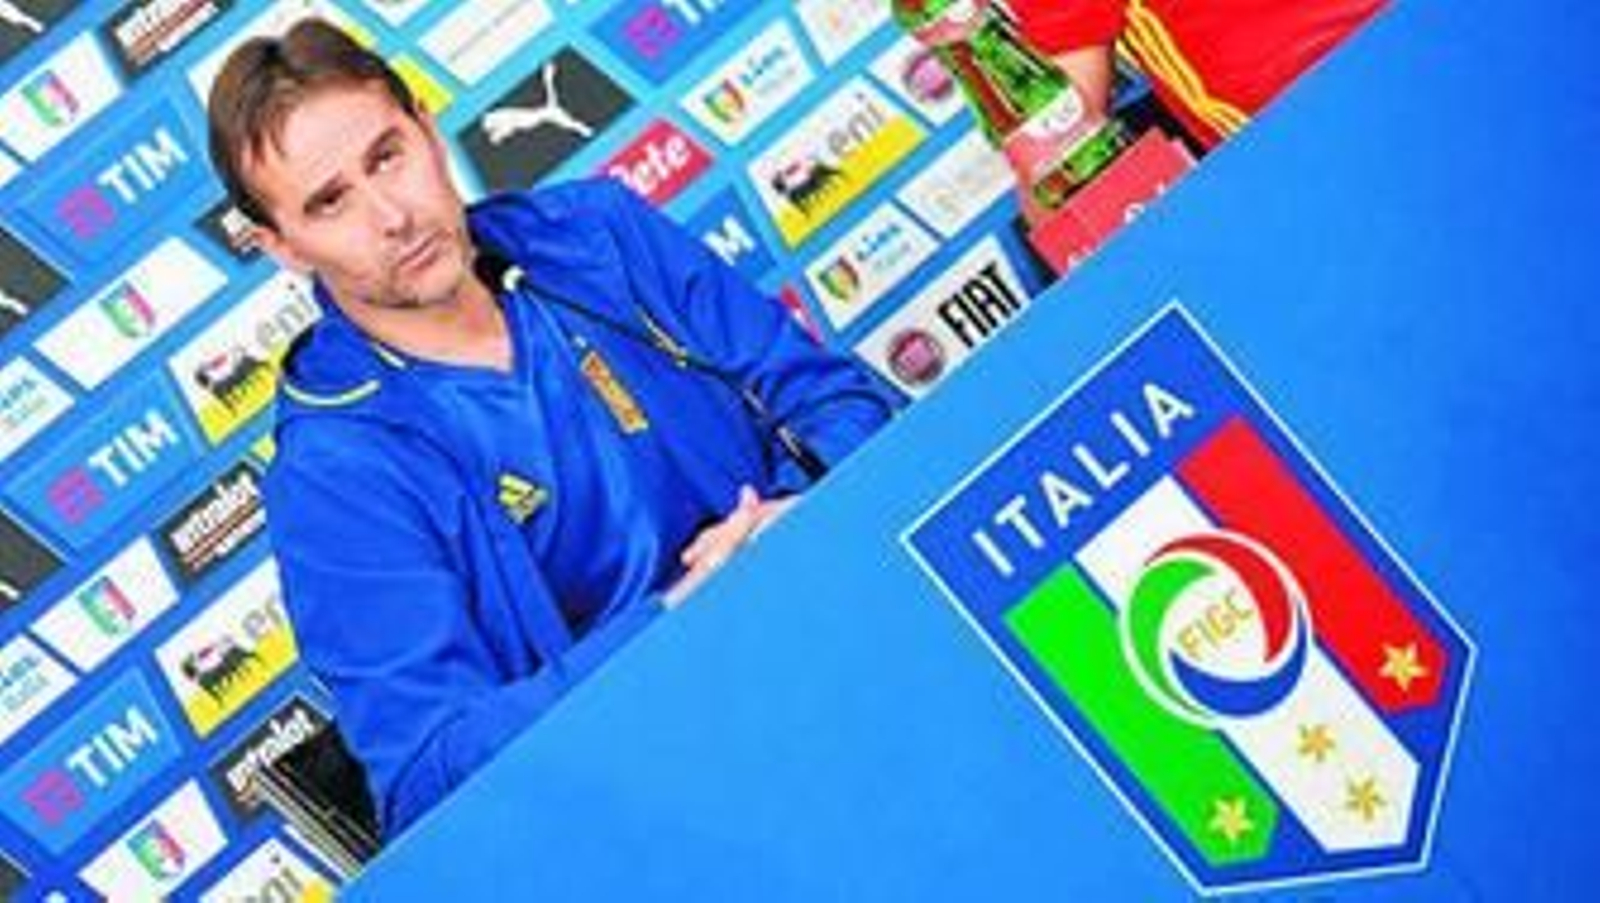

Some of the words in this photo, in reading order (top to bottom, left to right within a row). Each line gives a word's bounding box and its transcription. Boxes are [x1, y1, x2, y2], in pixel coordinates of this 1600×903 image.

[827, 91, 885, 156] eni
[98, 126, 190, 204] TIM
[938, 261, 1021, 348] FIAT
[87, 408, 181, 488] TIM
[972, 383, 1196, 577] ITALIA
[1175, 589, 1252, 657] FIGC
[64, 705, 159, 790] TIM
